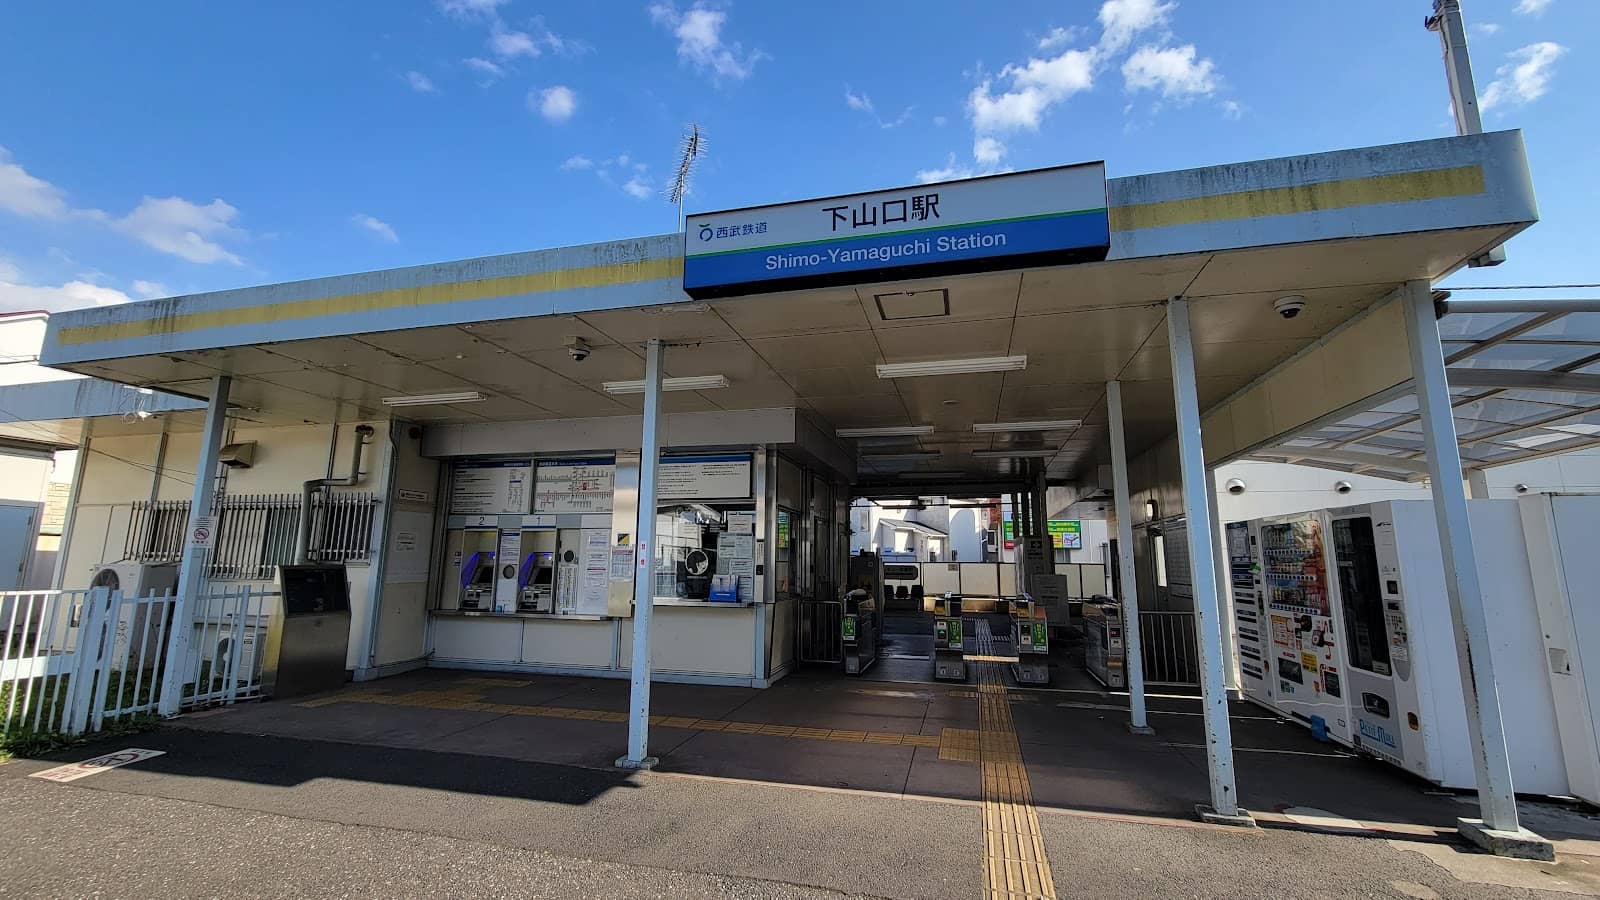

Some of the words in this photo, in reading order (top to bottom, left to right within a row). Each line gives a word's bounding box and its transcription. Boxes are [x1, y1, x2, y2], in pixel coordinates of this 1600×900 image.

[822, 194, 940, 231] 下山口駅
[716, 222, 768, 239] 西武鉄道
[766, 238, 930, 270] Shimo-Yamaguchi
[937, 232, 1006, 251] Station
[478, 516, 485, 526] 2
